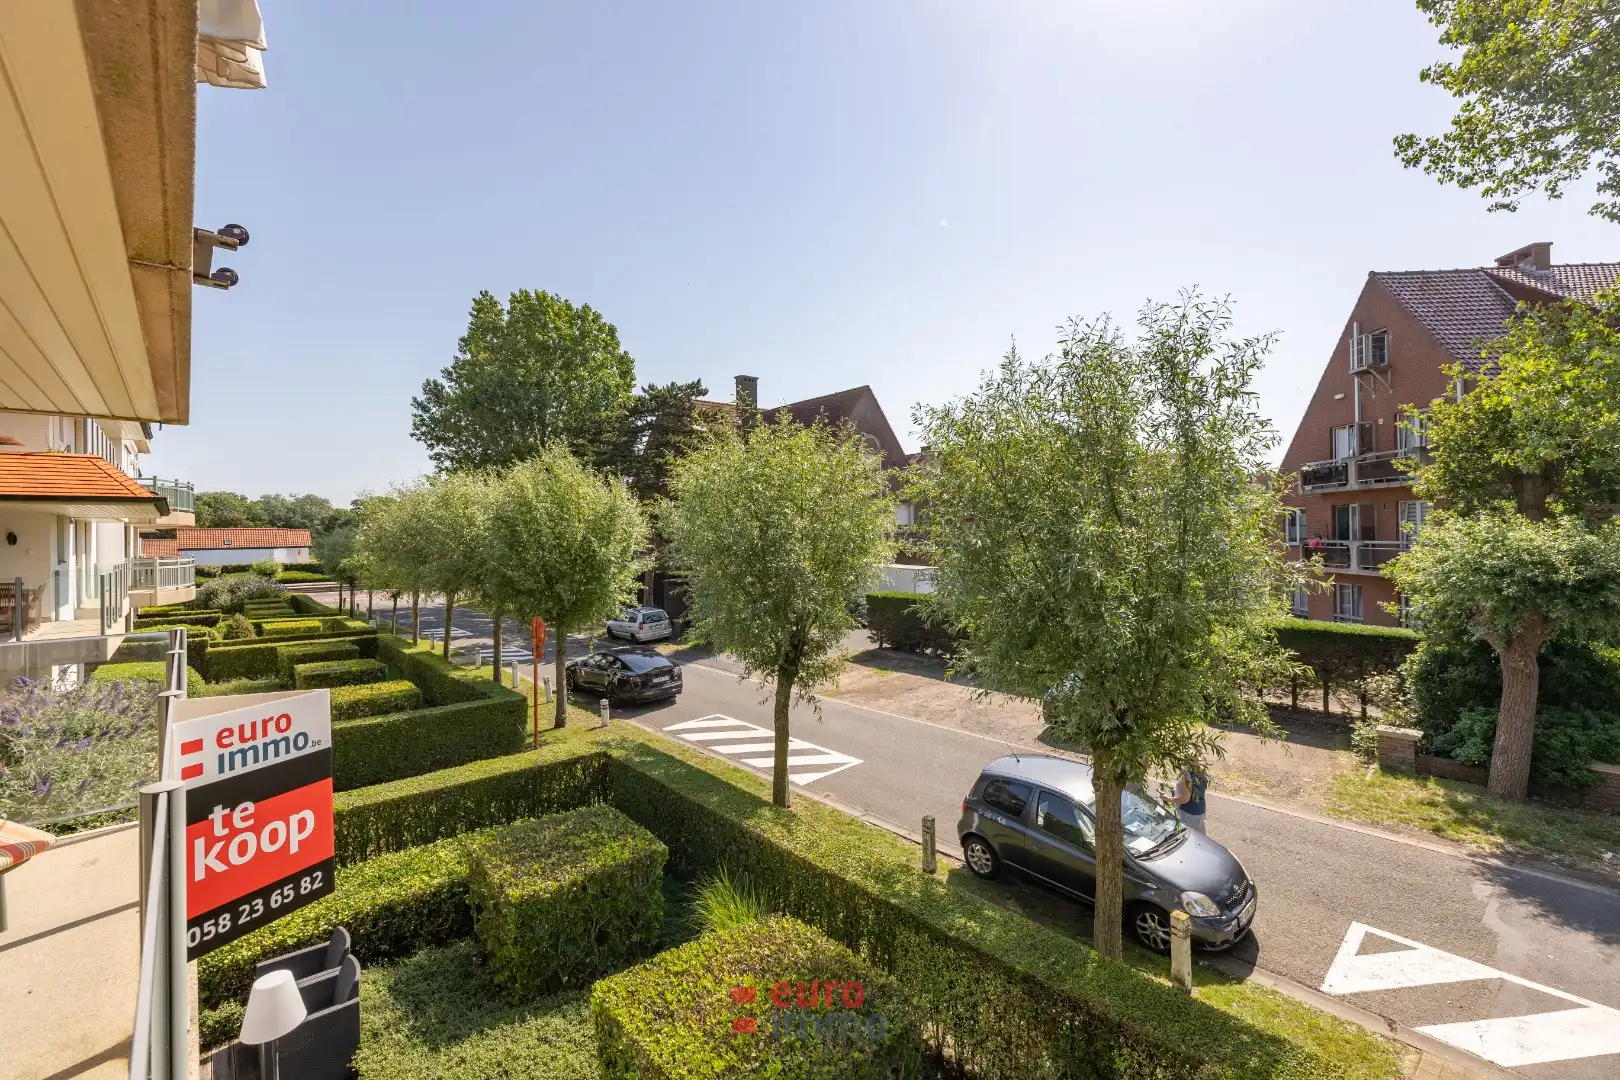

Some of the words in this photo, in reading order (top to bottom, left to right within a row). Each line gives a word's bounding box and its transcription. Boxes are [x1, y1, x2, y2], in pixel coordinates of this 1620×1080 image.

[215, 713, 292, 749] euro
[193, 809, 315, 882] koop
[208, 801, 255, 837] te
[187, 913, 231, 948] 058
[237, 899, 264, 925] 23
[270, 883, 294, 909] 65
[300, 871, 323, 895] 82
